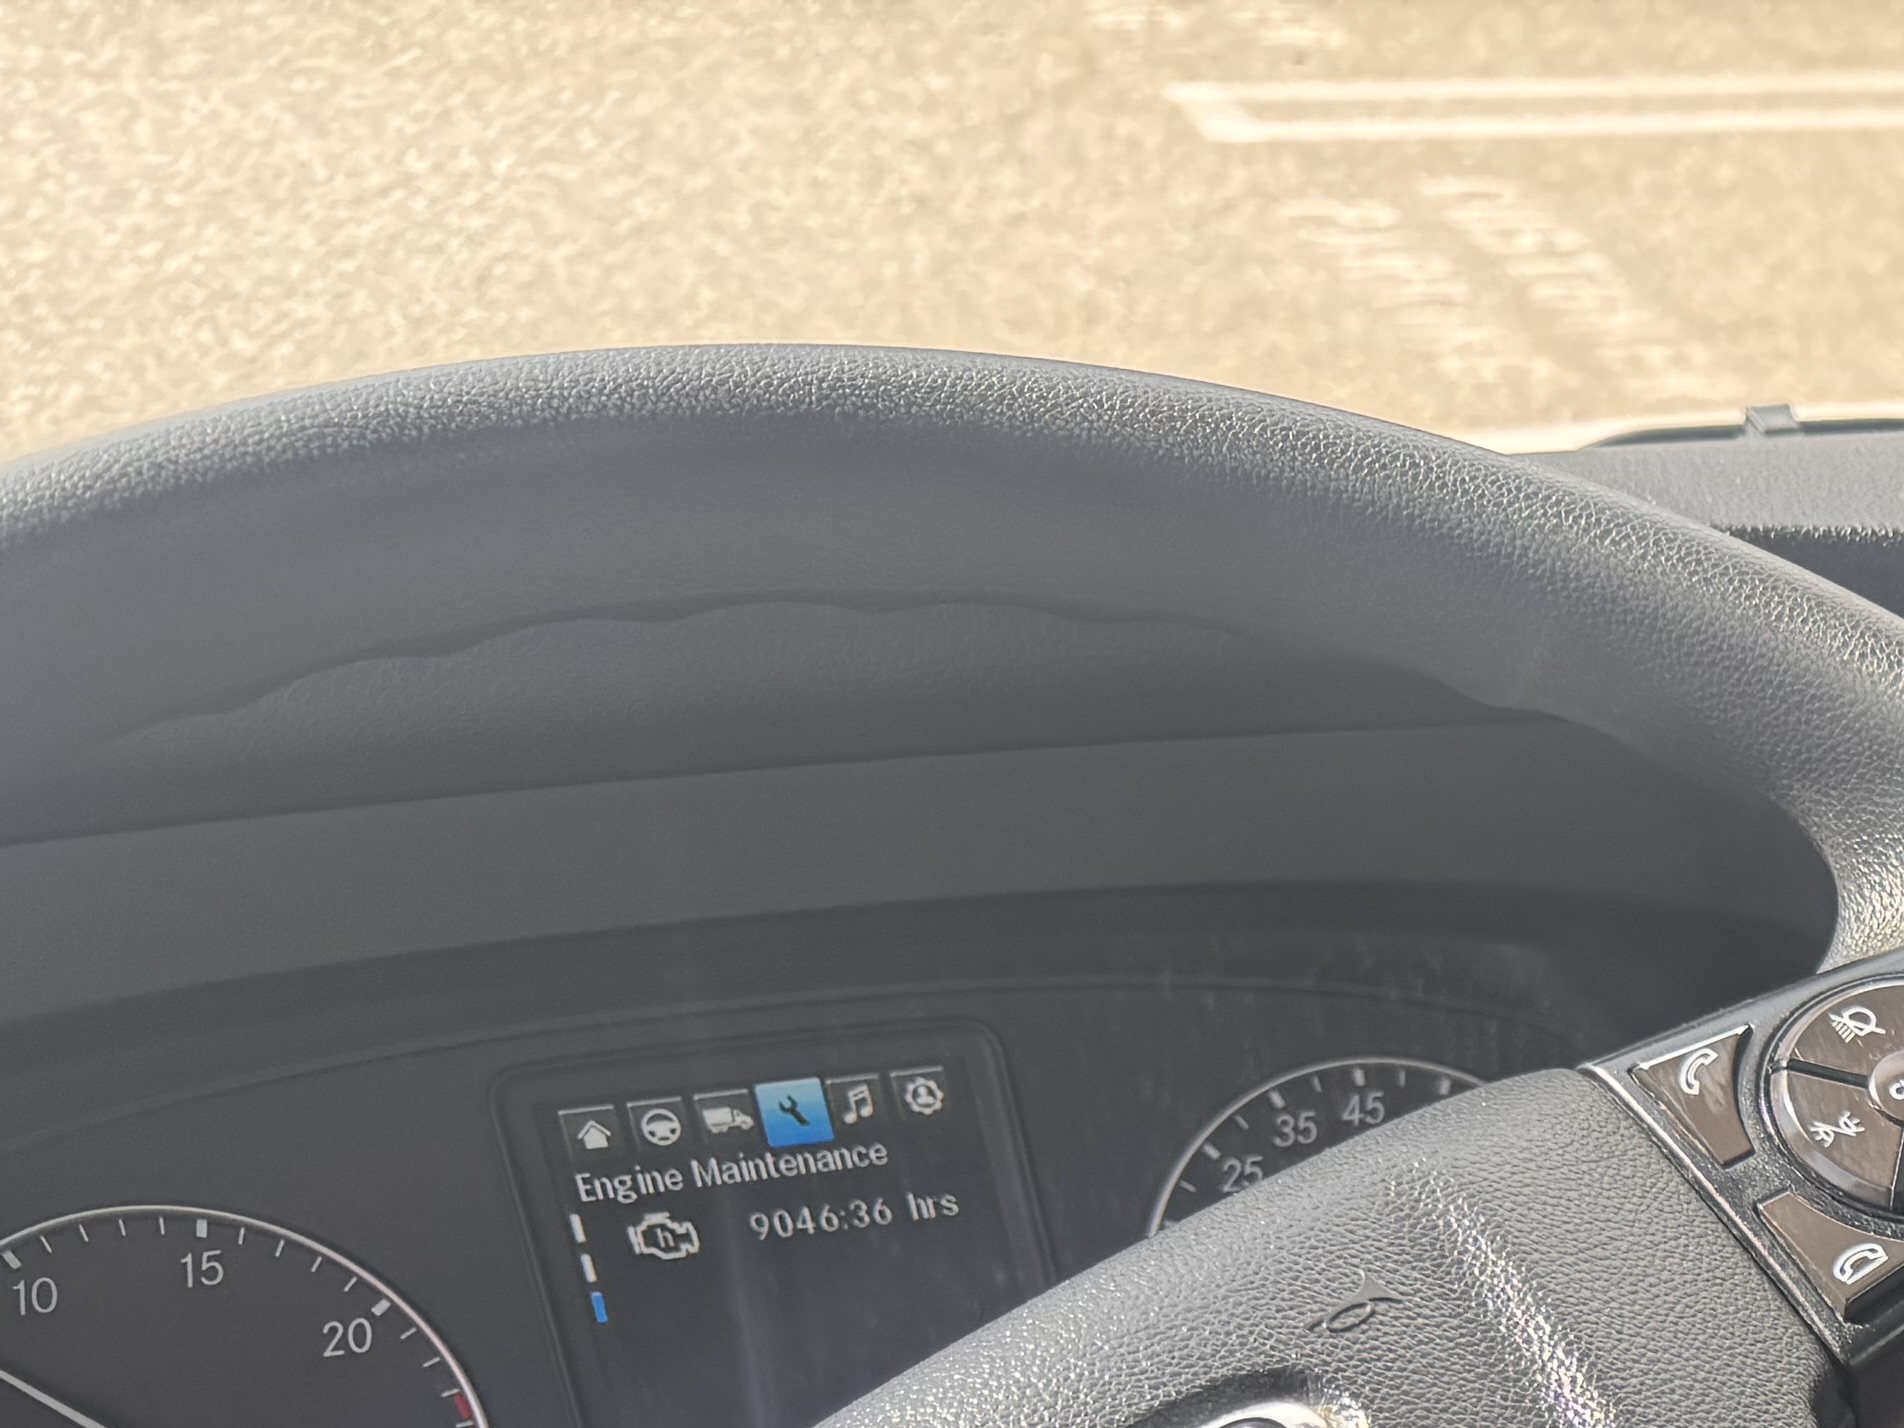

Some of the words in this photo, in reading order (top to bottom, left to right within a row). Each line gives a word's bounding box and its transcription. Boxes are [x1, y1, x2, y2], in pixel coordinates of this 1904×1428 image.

[1342, 1091, 1385, 1126] 45
[1272, 1111, 1318, 1148] 35
[575, 1166, 684, 1204] Engine
[691, 1142, 889, 1188] Maintenance
[750, 1199, 893, 1241] 9046:36
[906, 1190, 960, 1222] hrs
[180, 1250, 225, 1288] 15
[12, 1277, 58, 1316] 10
[322, 1318, 373, 1357] 20
